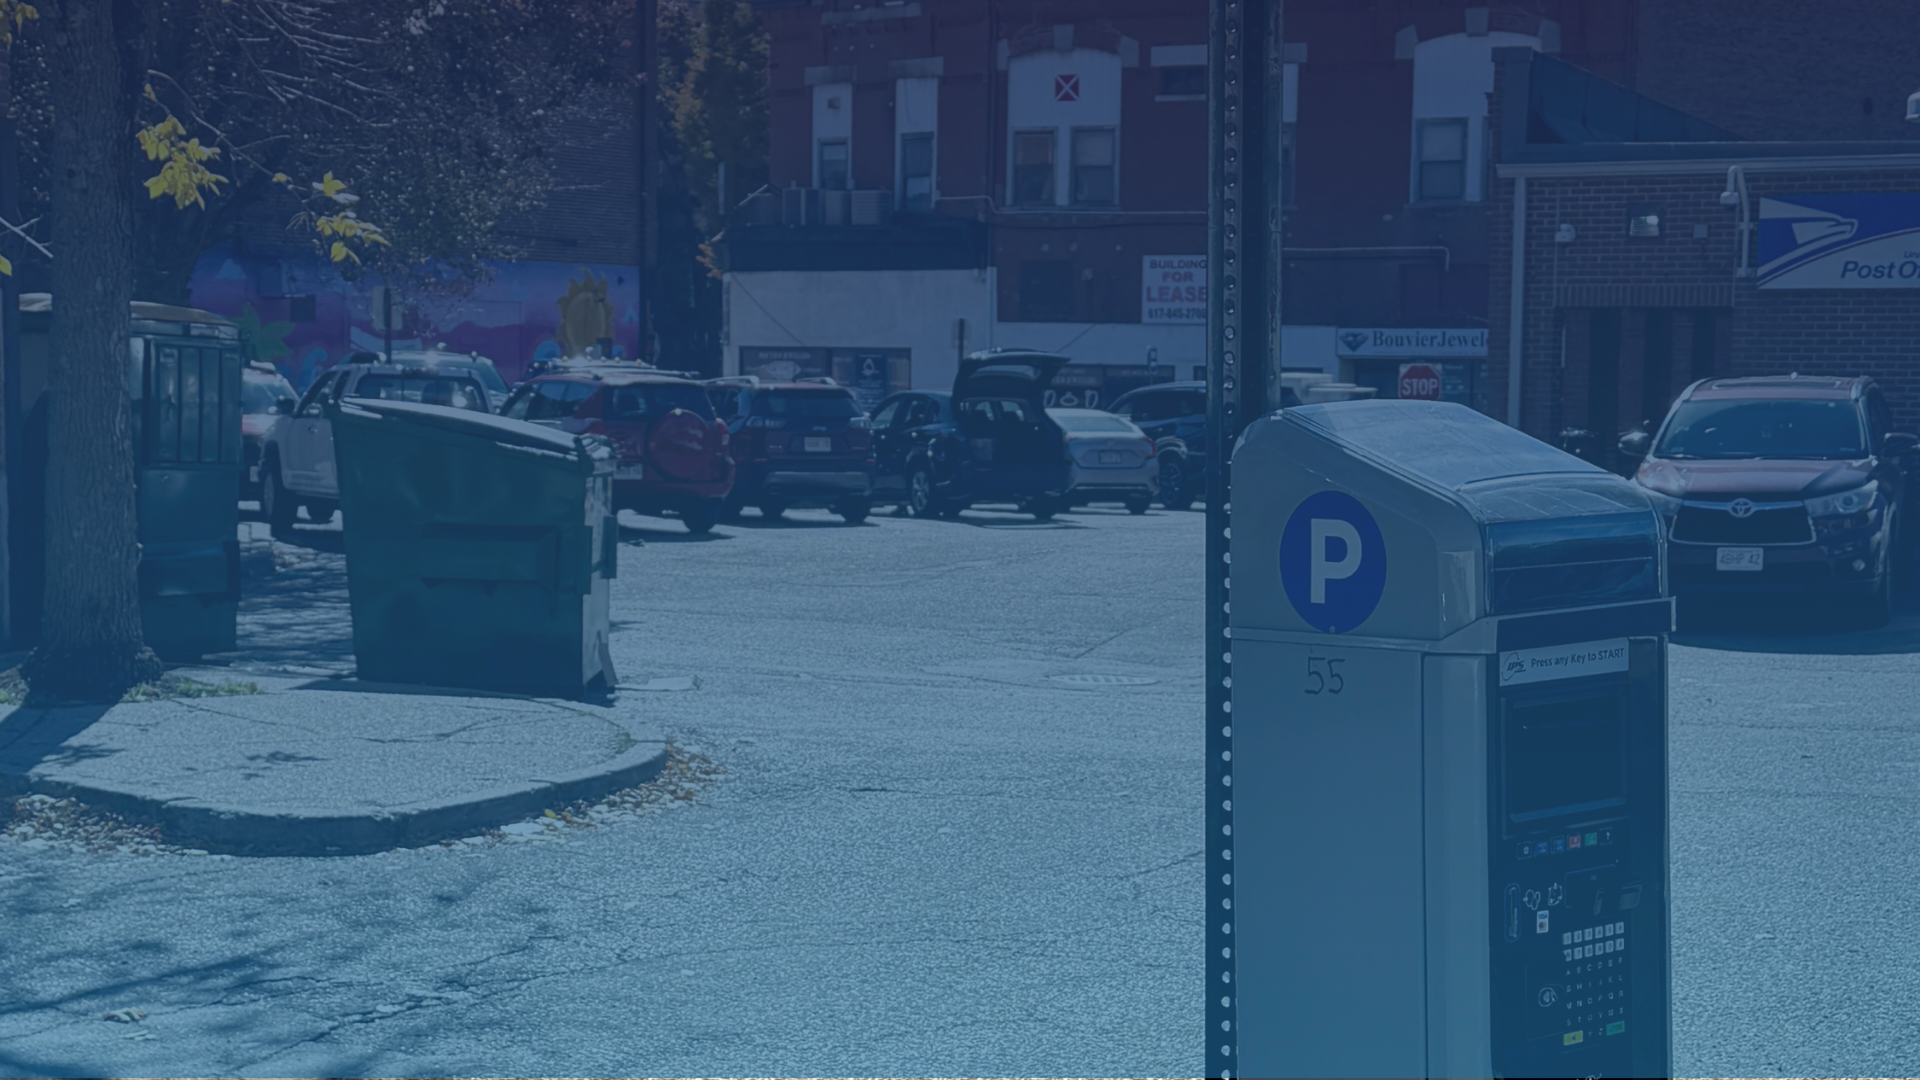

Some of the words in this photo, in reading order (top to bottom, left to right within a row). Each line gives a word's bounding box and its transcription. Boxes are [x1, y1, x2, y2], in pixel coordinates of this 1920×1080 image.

[1150, 259, 1206, 269] BUILDING
[1841, 260, 1896, 279] Post
[1162, 271, 1194, 282] FOR
[1146, 286, 1206, 302] LEASE
[1372, 330, 1488, 347] BouvierJewel
[1401, 378, 1438, 396] STOP
[1311, 518, 1362, 604] P
[1531, 658, 1552, 668] Press
[1554, 656, 1569, 666] any
[1570, 653, 1586, 664] Key
[1587, 652, 1596, 661] to
[1598, 648, 1625, 660] START
